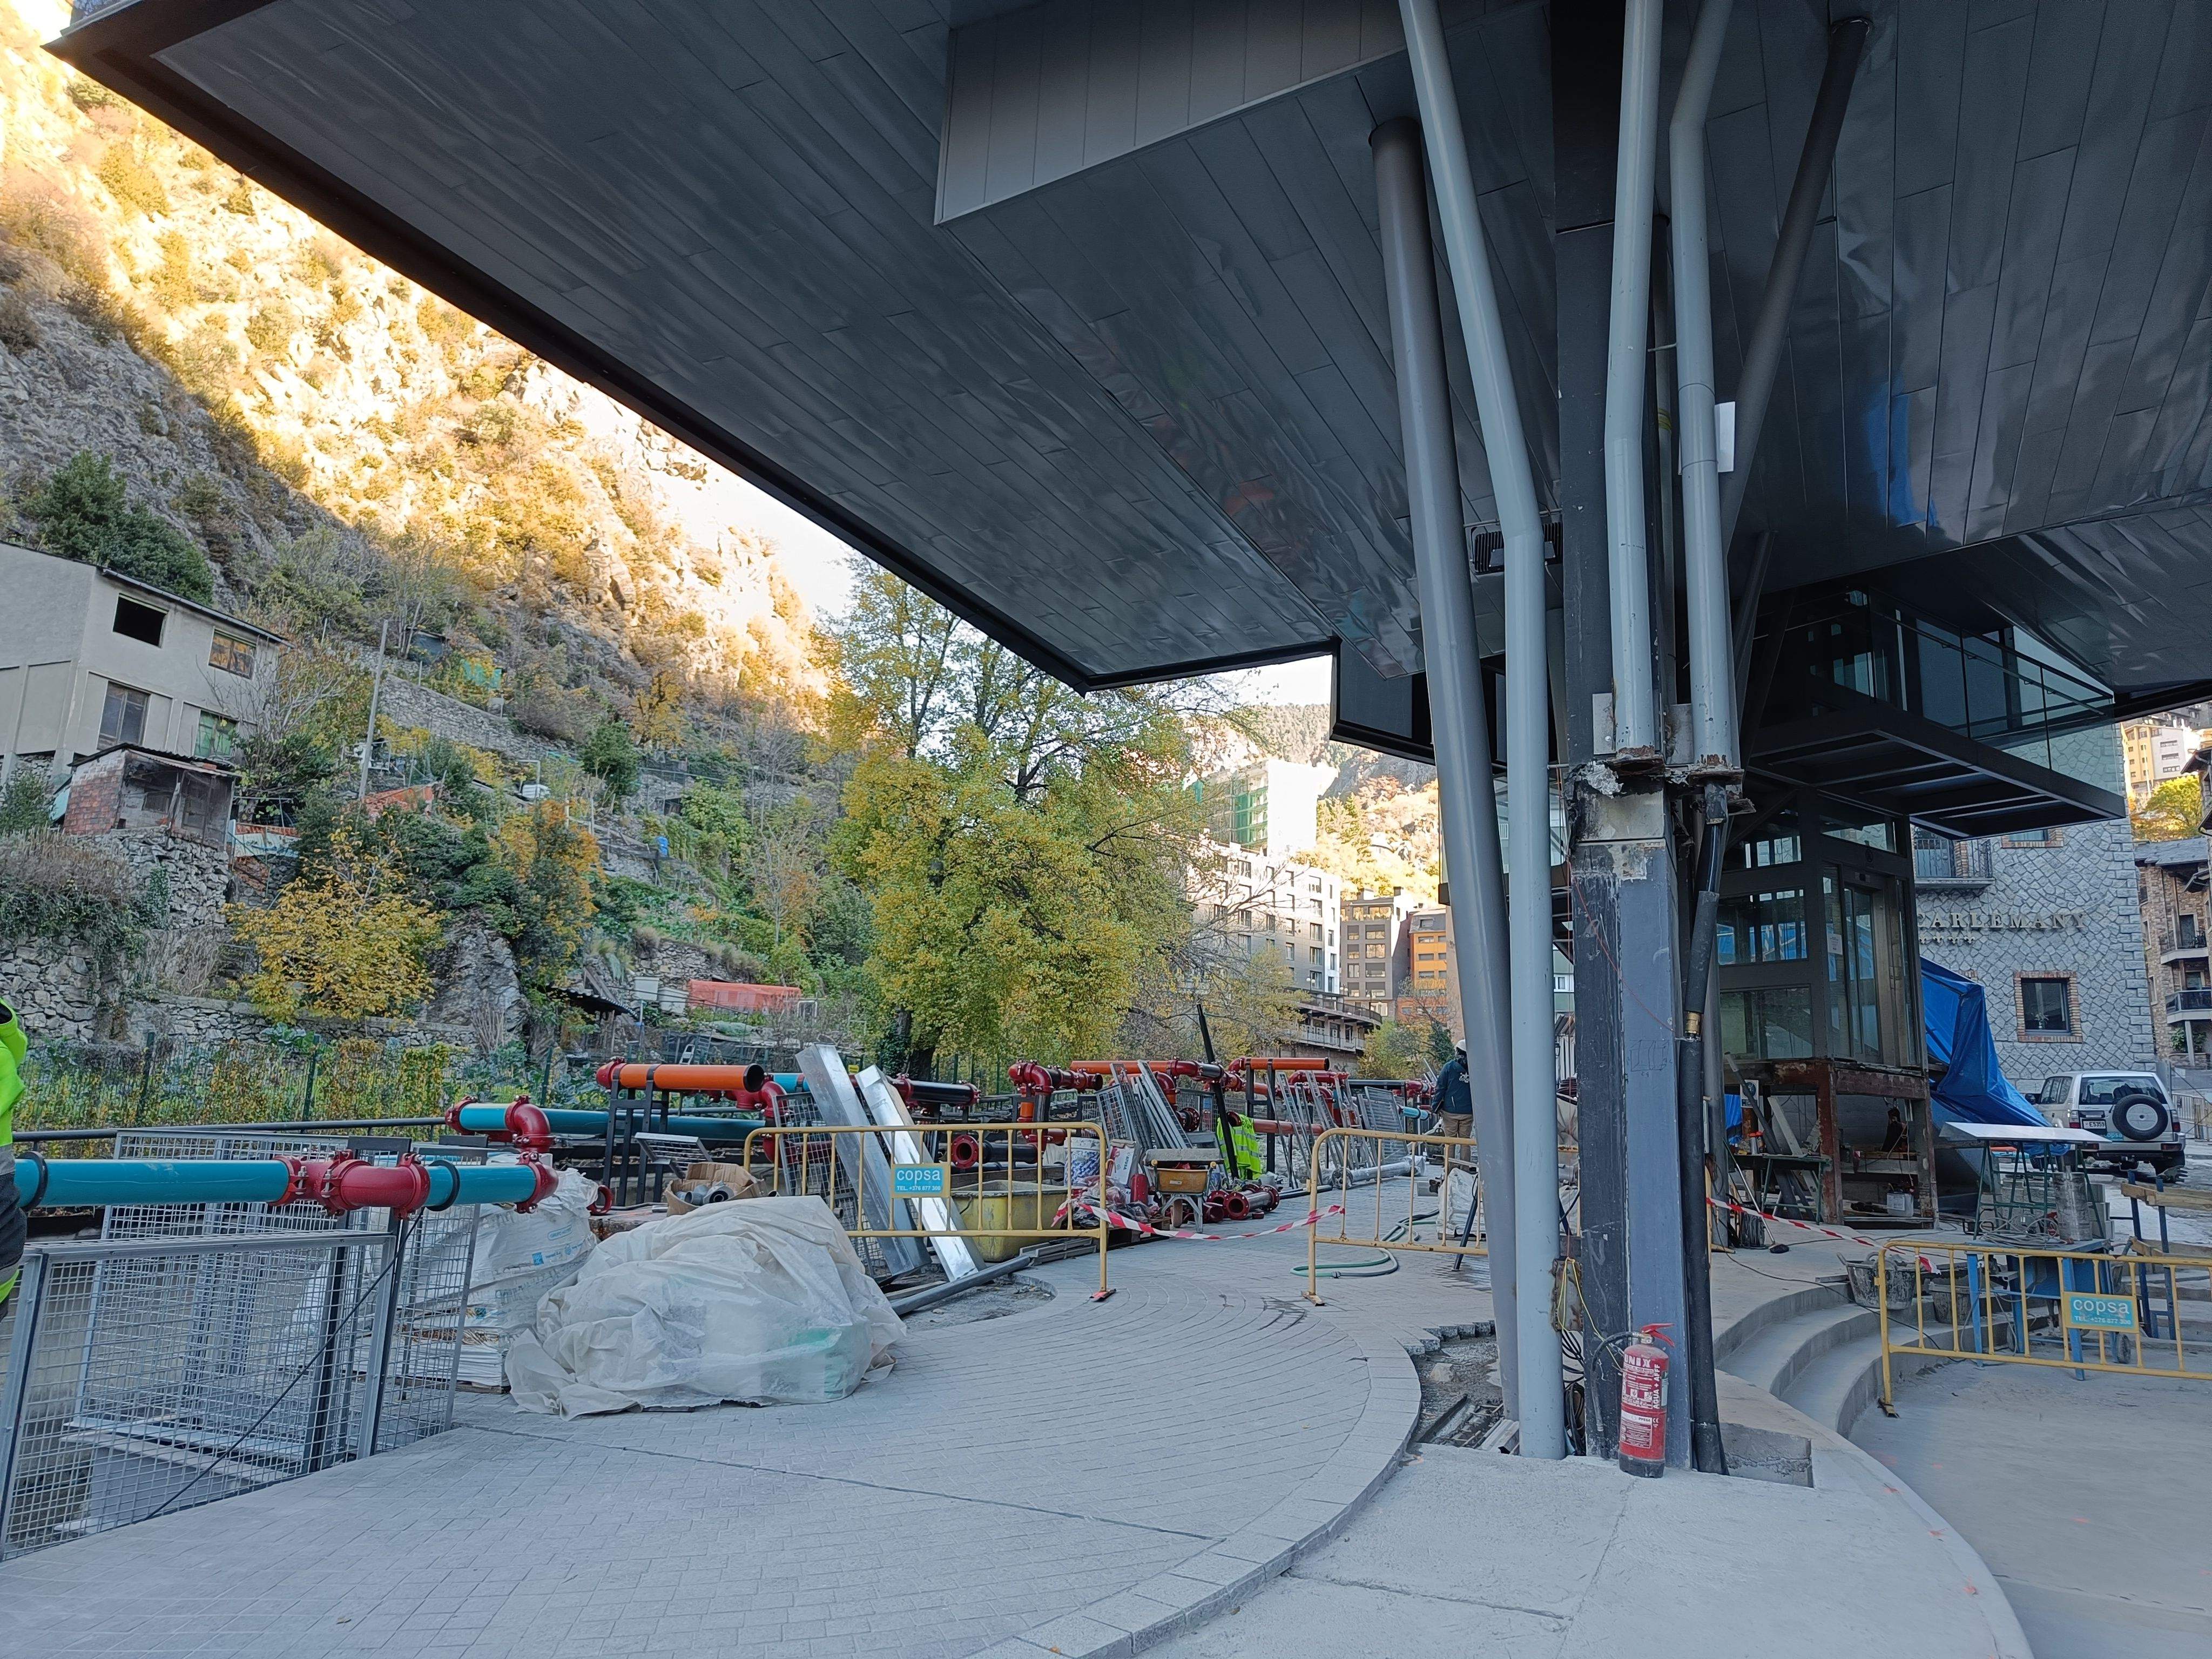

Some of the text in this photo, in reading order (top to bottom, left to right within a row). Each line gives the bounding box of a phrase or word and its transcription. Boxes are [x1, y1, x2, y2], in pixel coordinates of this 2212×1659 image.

[896, 1170, 941, 1186] copsa
[2073, 1299, 2129, 1315] copsa
[1624, 1354, 1651, 1368] UNIX
